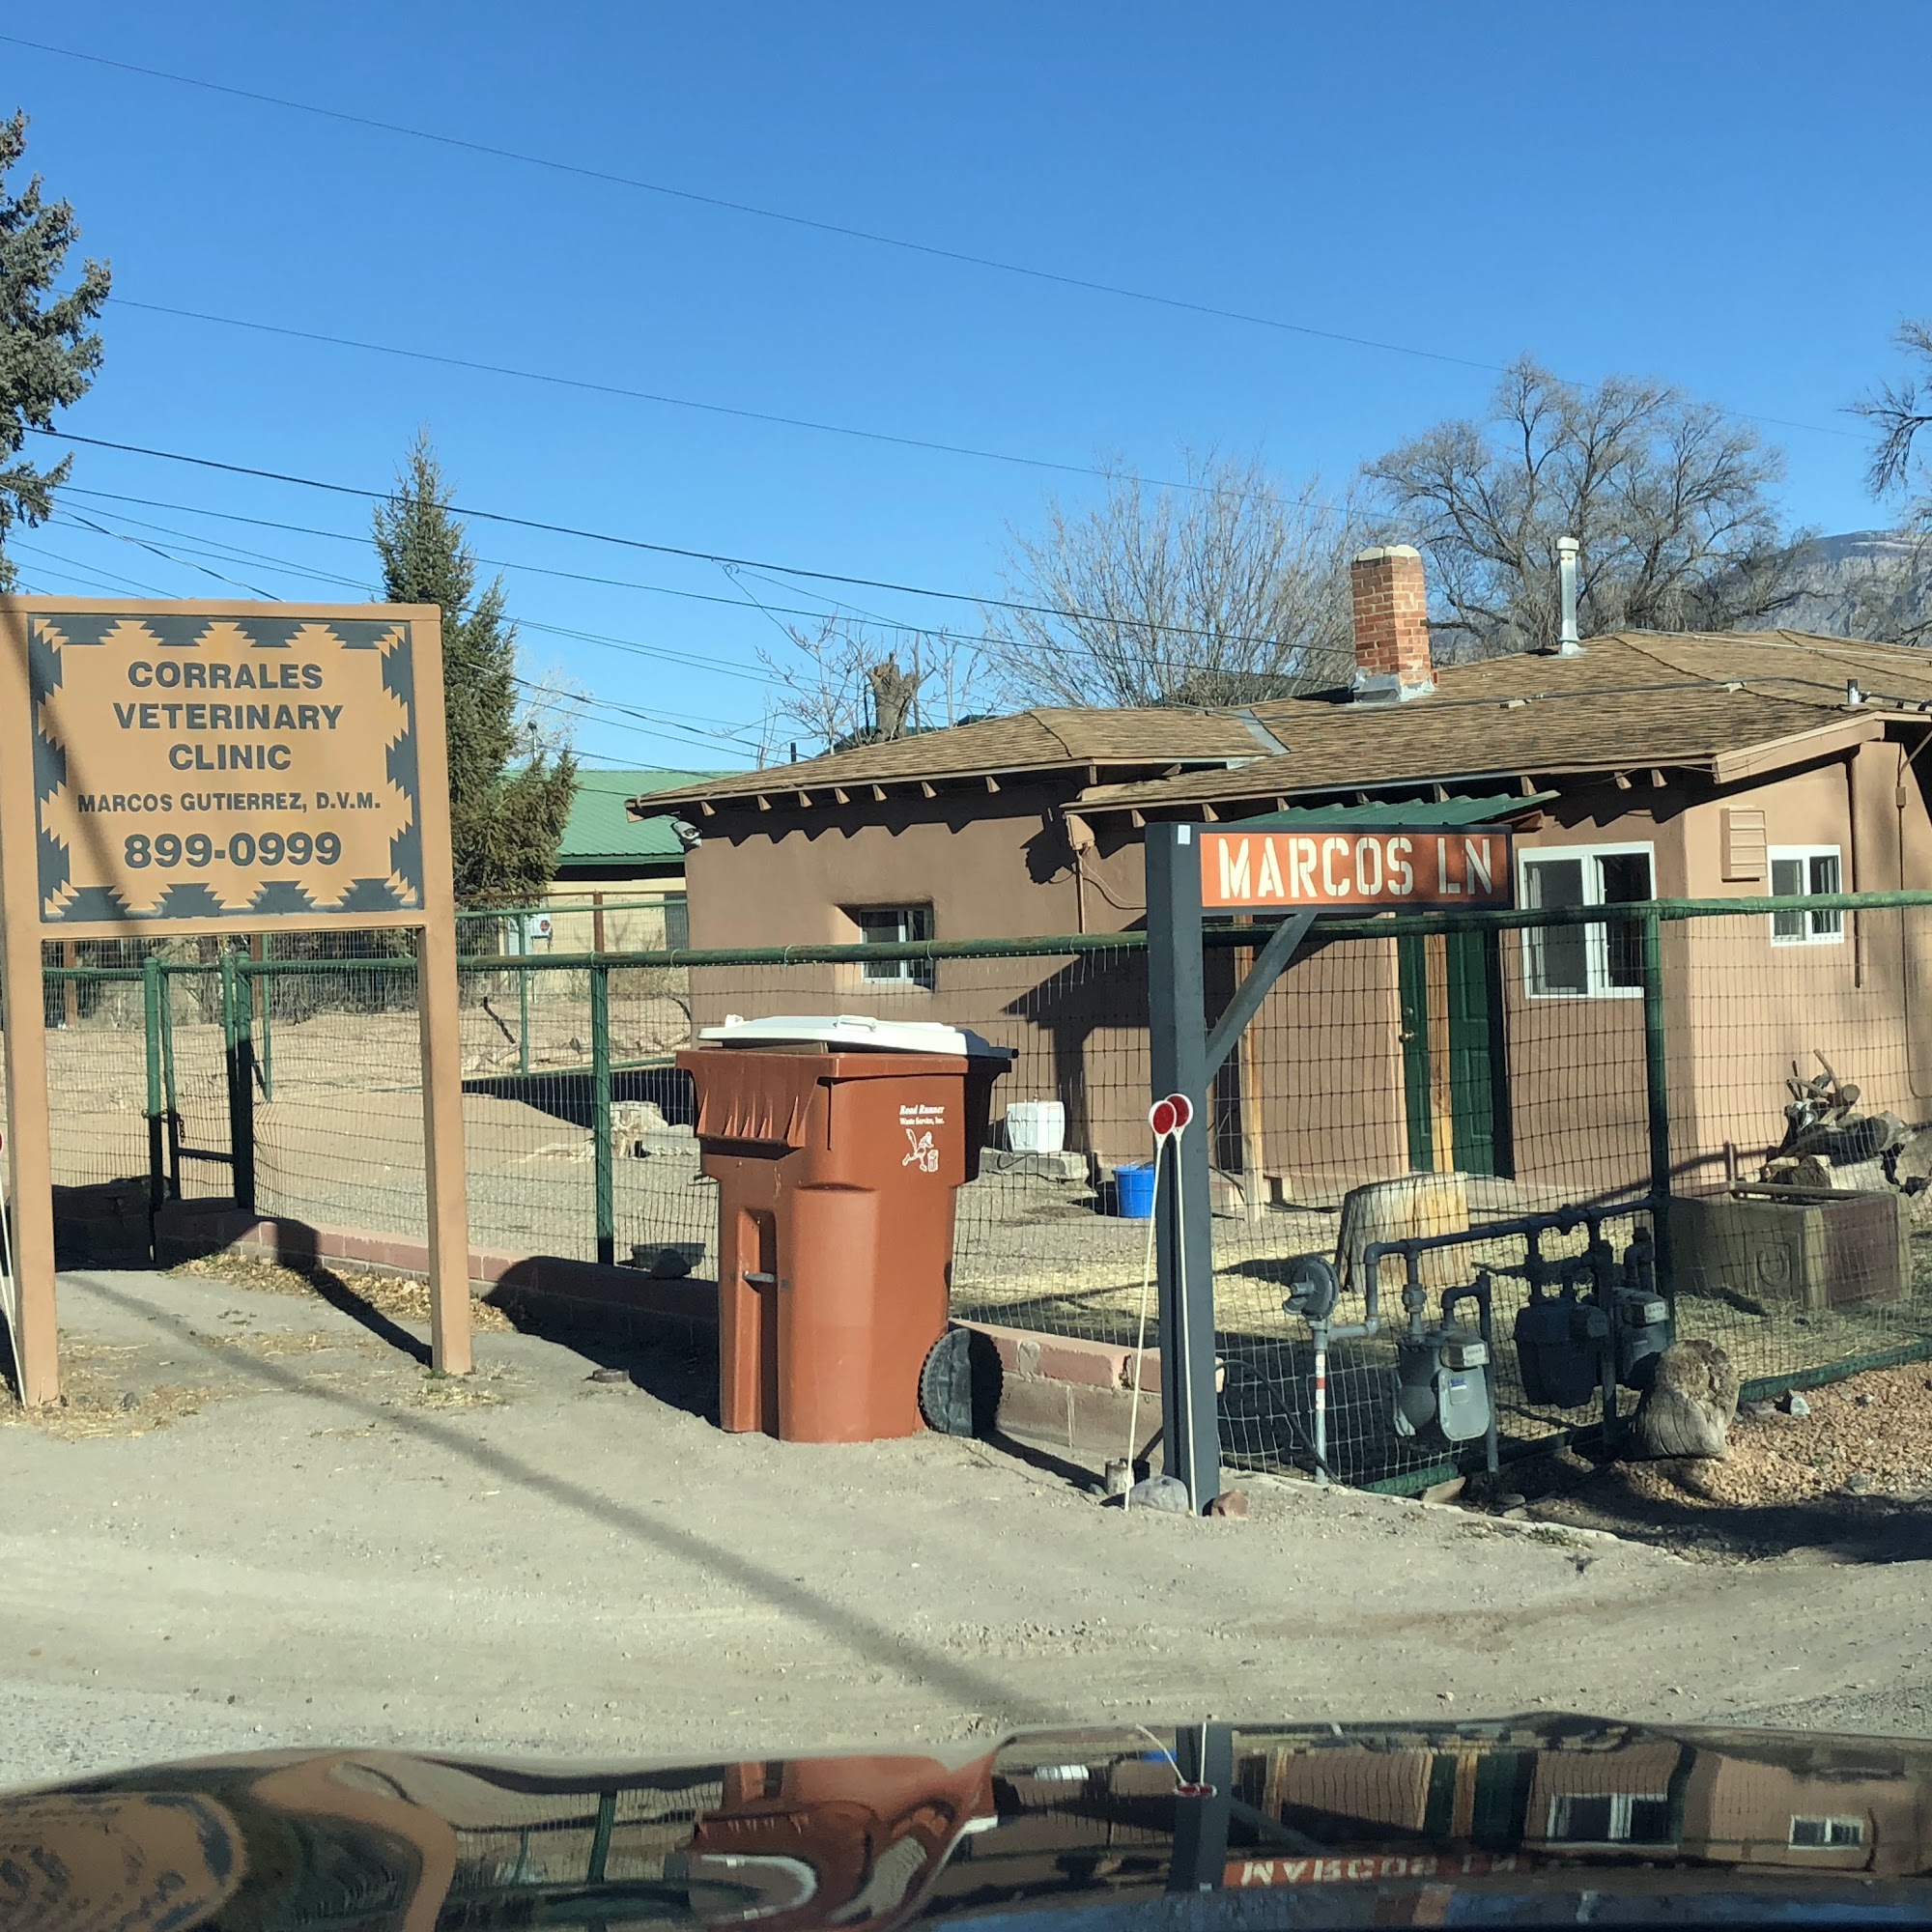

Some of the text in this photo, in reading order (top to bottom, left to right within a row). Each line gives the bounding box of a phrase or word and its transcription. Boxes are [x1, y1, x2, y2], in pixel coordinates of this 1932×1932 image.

[128, 661, 323, 689] CORRALES
[113, 702, 344, 729] VETERINARY
[168, 744, 292, 771] CLINIC
[77, 791, 382, 813] MARCOS GUTIERREZ, D.V.M.
[123, 831, 342, 868] 899-0999
[1218, 837, 1492, 899] MARCOS LN
